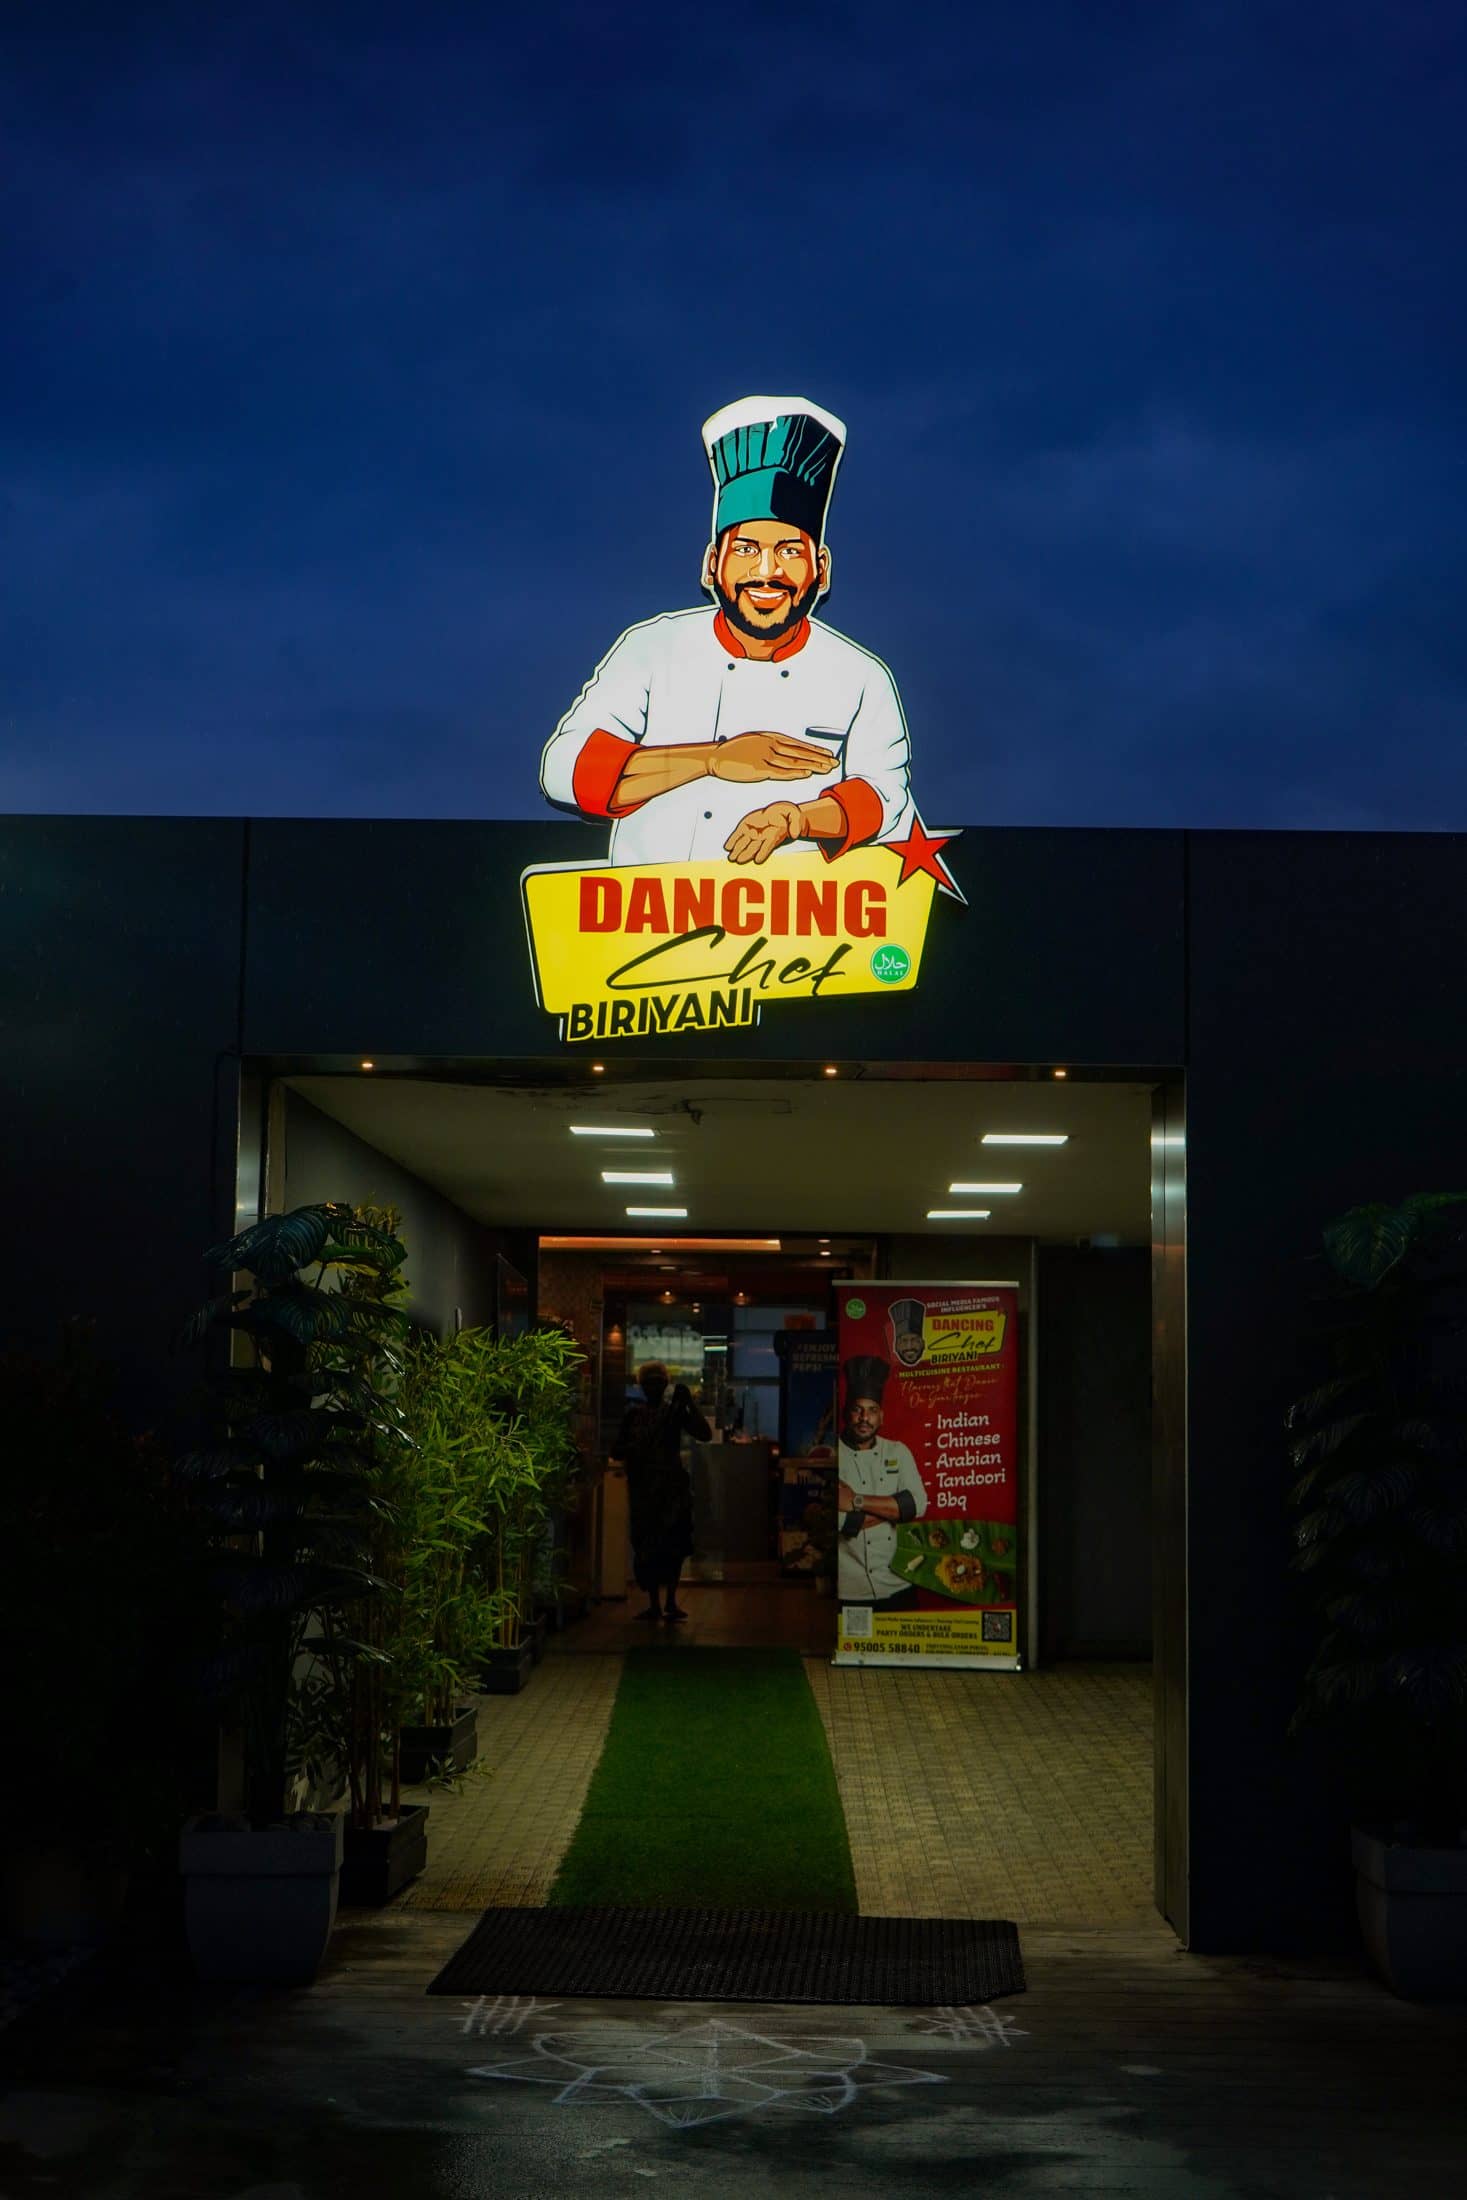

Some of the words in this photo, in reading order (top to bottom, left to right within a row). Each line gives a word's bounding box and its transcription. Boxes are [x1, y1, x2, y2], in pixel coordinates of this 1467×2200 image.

[579, 877, 887, 937] DANCING
[606, 926, 852, 997] Chef
[875, 953, 907, 970] حلال
[569, 986, 752, 1041] BIRIYANI
[951, 1298, 971, 1306] MEDIA
[932, 1318, 994, 1332] DANCING
[928, 1332, 996, 1352] Chef
[931, 1351, 978, 1364] BIRIYANI
[898, 1367, 950, 1377] MULTICUISINE
[952, 1363, 1001, 1373] RESTAURANT
[937, 1411, 990, 1430] Indian
[936, 1431, 1001, 1449] Chinese
[936, 1450, 1002, 1469] Arabian
[936, 1467, 1006, 1488] Tandoori
[936, 1491, 968, 1512] Bbq
[877, 1629, 898, 1637] PARTY
[854, 1641, 886, 1653] 95005
[888, 1642, 920, 1654] 58840
